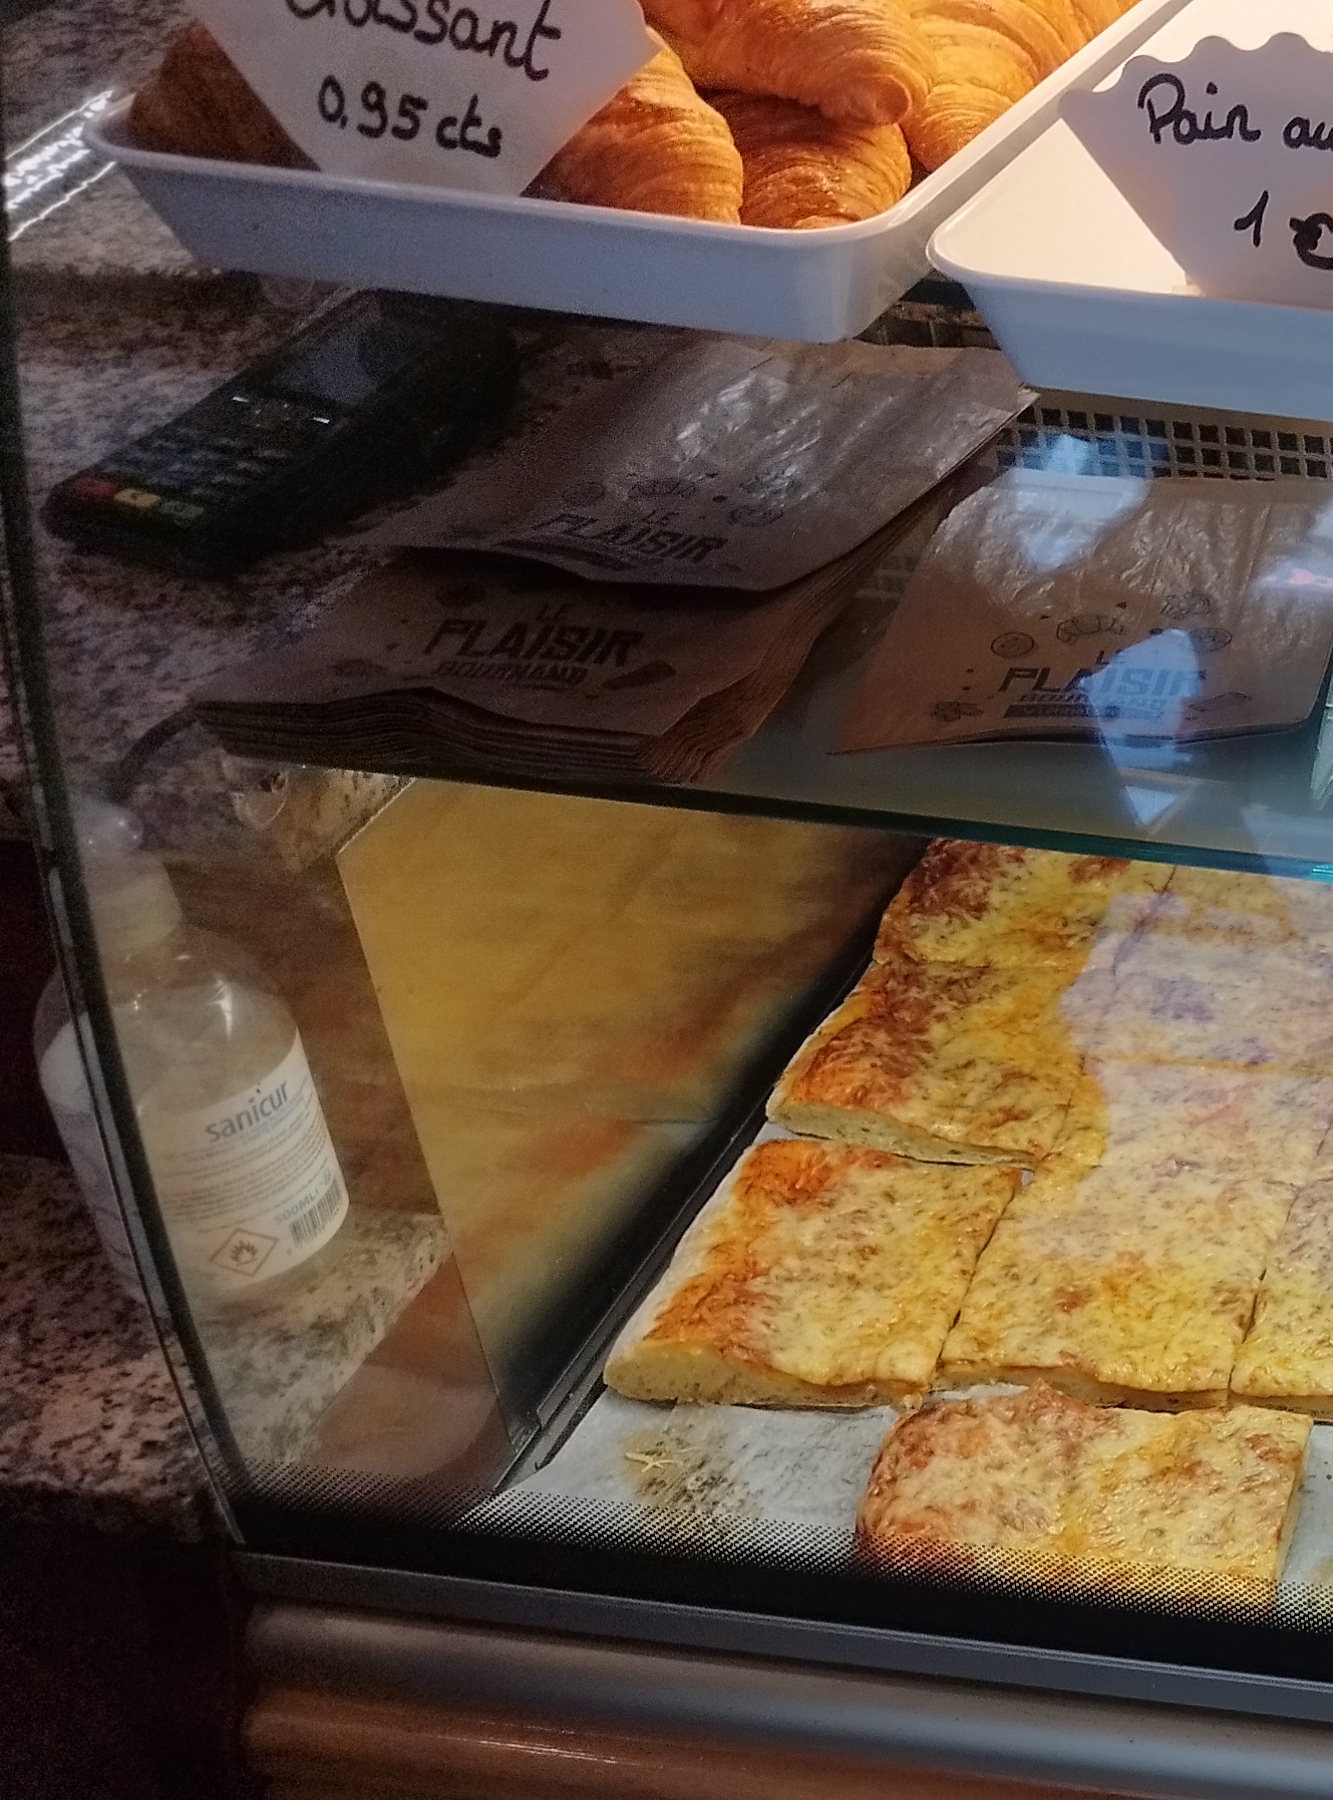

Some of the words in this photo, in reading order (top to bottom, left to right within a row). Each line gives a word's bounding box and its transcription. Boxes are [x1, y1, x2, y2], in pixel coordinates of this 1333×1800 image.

[285, 0, 562, 81] oissant
[318, 75, 430, 141] 0,95
[436, 93, 502, 159] cts
[1138, 72, 1261, 144] Pain
[422, 617, 645, 668] PLAISIR
[998, 666, 1207, 697] PLAISIR
[204, 1079, 290, 1144] sanicur
